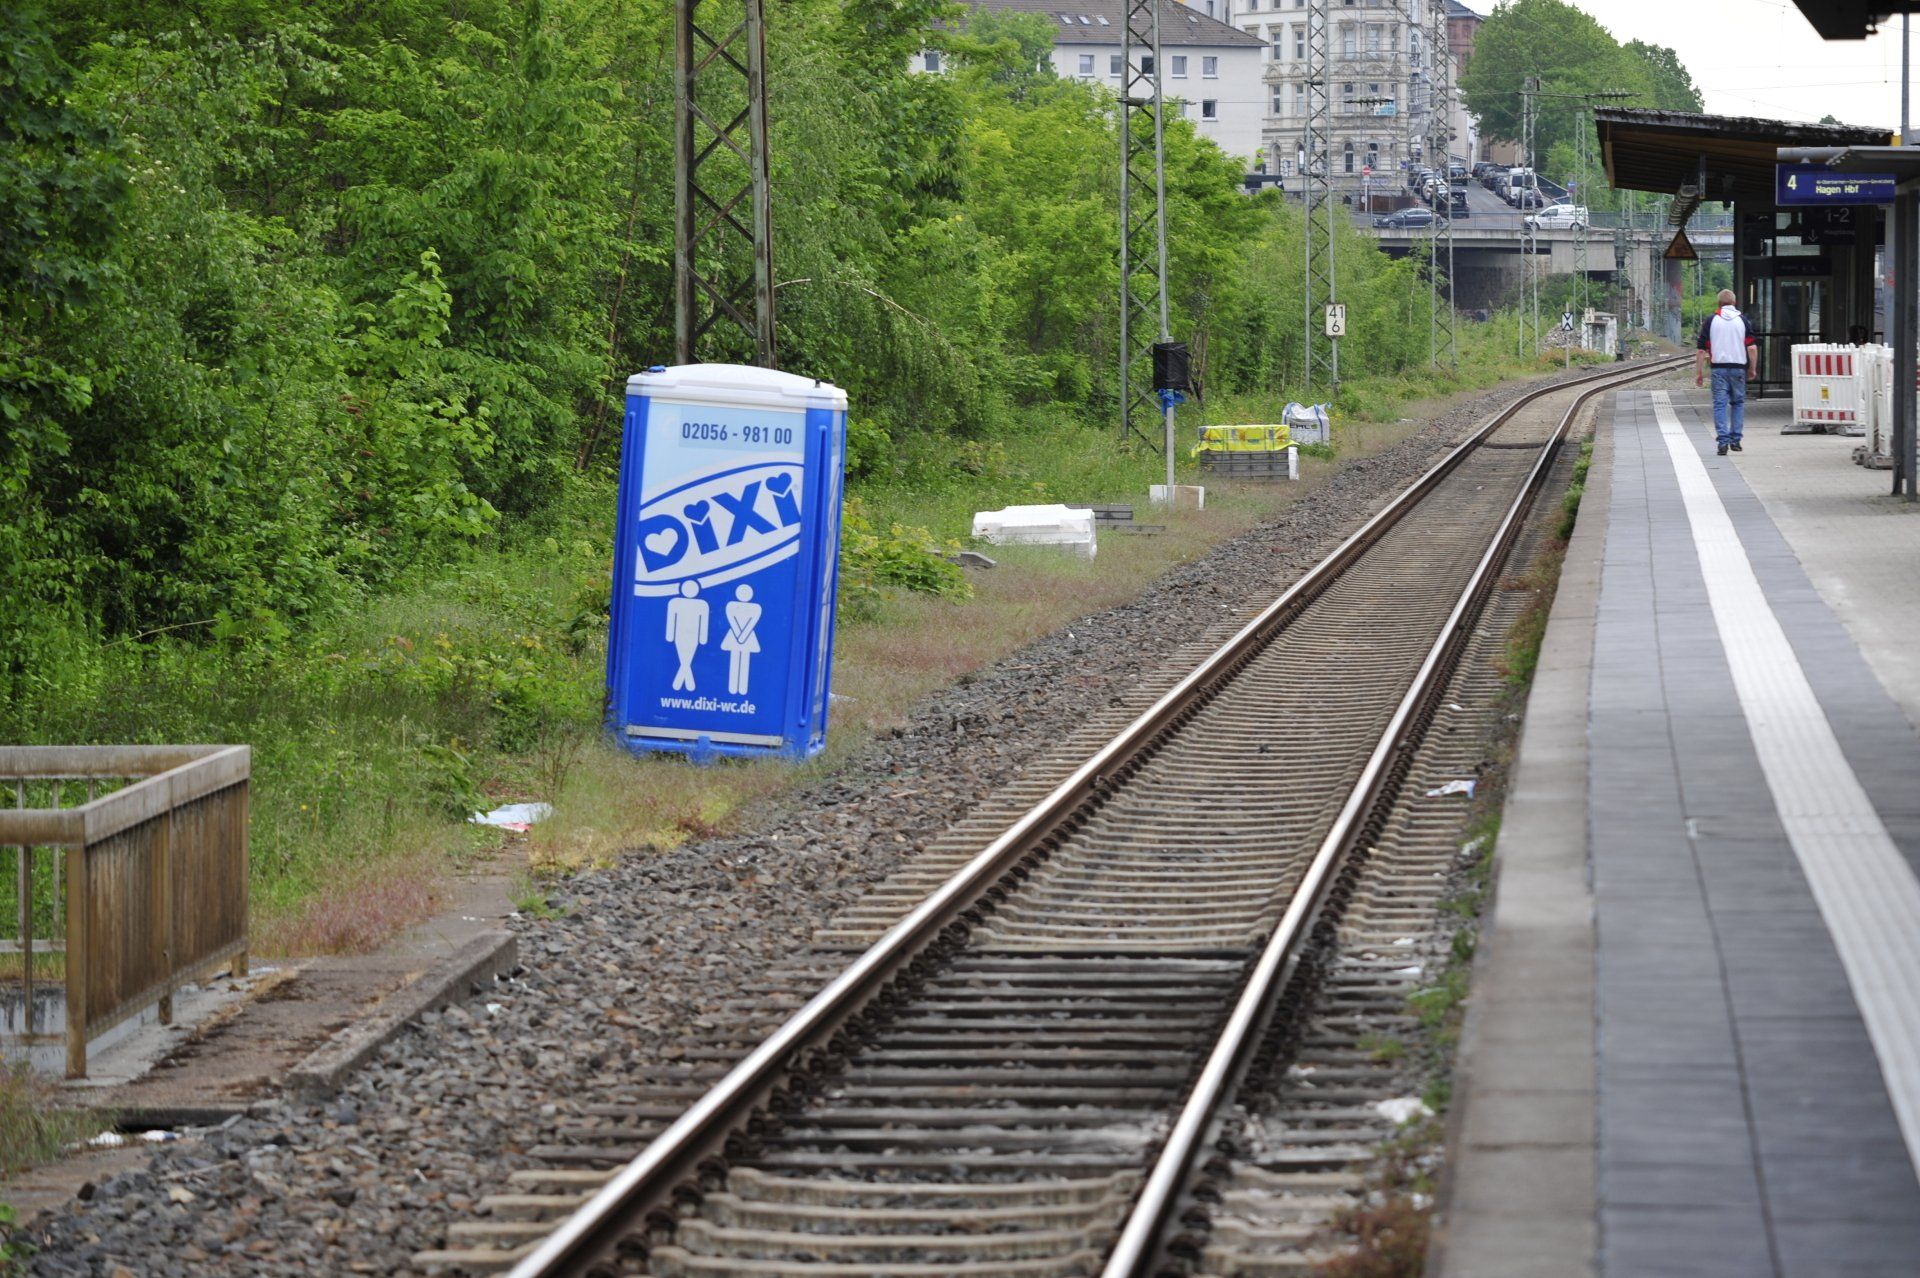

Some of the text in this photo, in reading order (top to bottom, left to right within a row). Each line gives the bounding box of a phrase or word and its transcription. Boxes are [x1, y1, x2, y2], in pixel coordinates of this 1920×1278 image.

[1788, 174, 1797, 190] 4
[1815, 184, 1860, 195] Hagen Hbf
[1824, 207, 1851, 223] 1-2
[1328, 306, 1344, 319] 41
[1332, 320, 1341, 333] 6
[682, 422, 728, 441] 02056
[743, 426, 769, 443] 981
[774, 428, 792, 445] 00
[660, 696, 756, 714] www.dixi-wc.de
